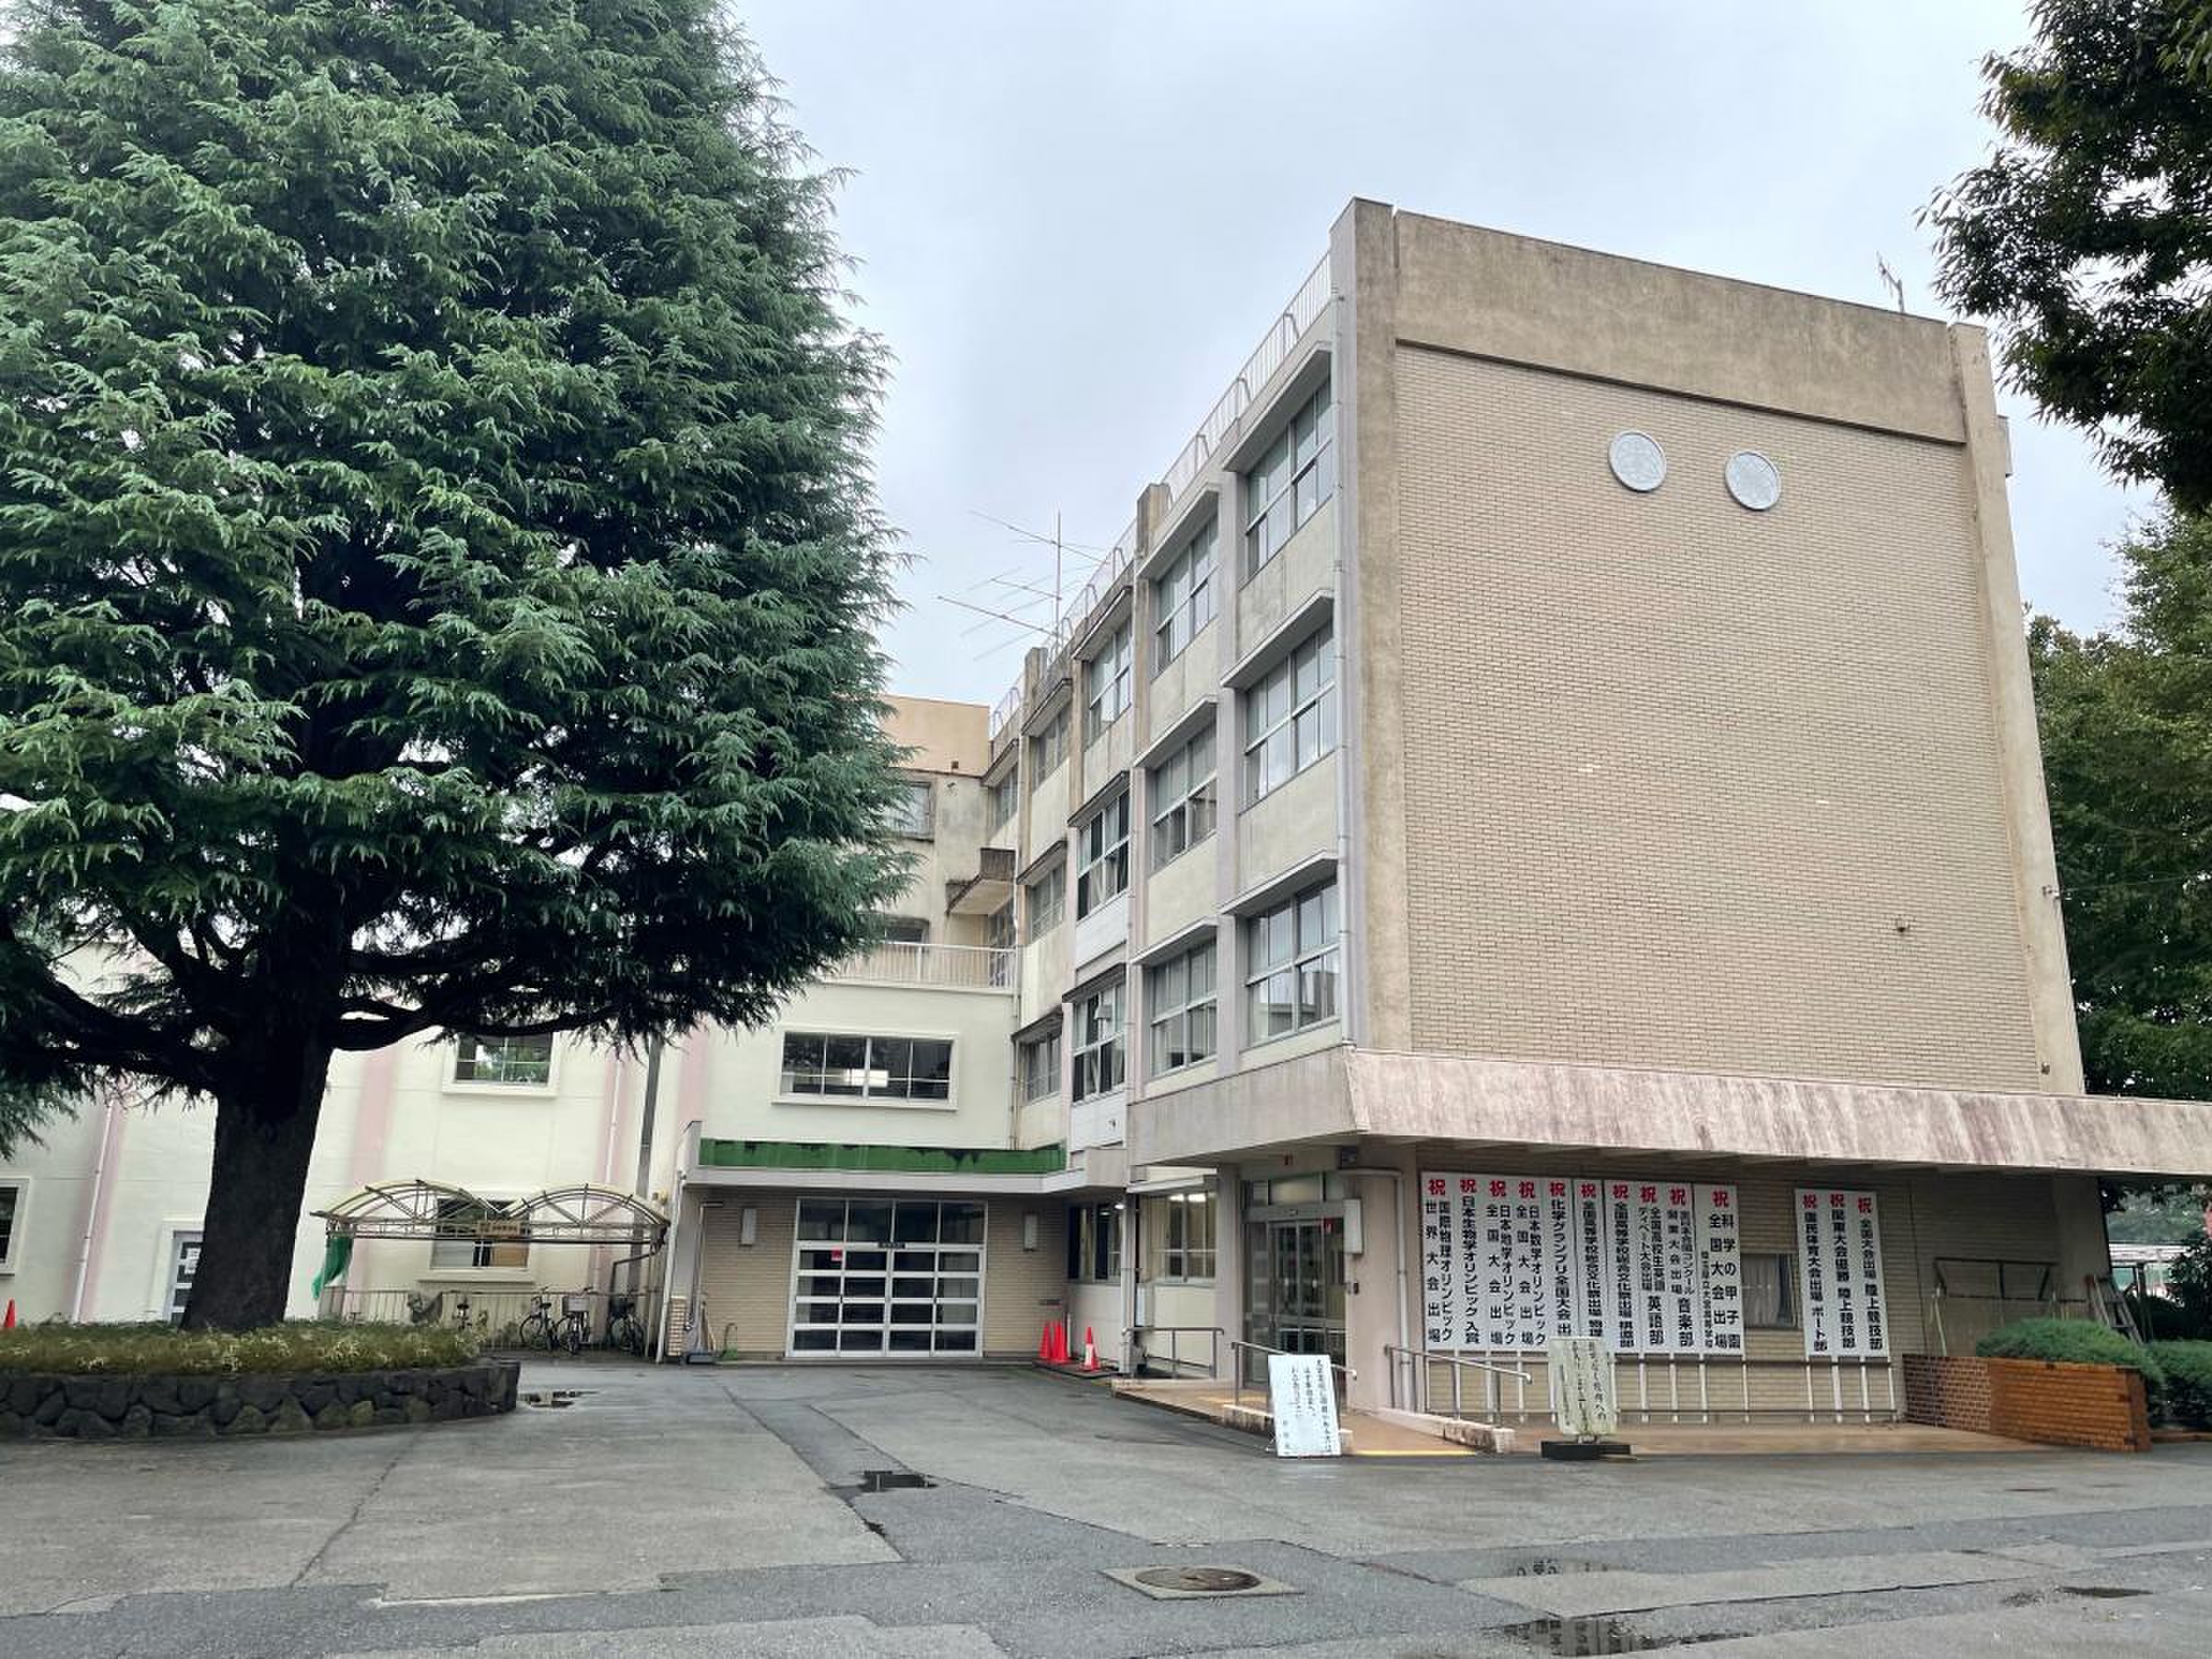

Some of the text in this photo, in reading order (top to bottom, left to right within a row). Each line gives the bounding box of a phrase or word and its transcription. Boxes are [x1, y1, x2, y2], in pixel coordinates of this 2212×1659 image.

[1430, 1179, 1445, 1195] 祝
[1460, 1179, 1477, 1194] 祝
[1488, 1181, 1506, 1196] 祝
[1518, 1181, 1535, 1198] 祝
[1549, 1182, 1566, 1197] 祝
[1581, 1183, 1596, 1198] 祝
[1613, 1184, 1629, 1198] 祝
[1641, 1186, 1656, 1203] 祝
[1669, 1188, 1686, 1206] 祝
[1712, 1191, 1728, 1207] 祝
[1803, 1194, 1818, 1208] 祝
[1830, 1194, 1844, 1207] 祝
[1857, 1197, 1872, 1213] 祝
[1551, 1199, 1571, 1335] 化学グランプリ全国大会出
[1710, 1213, 1727, 1348] 全国大会出場
[1723, 1214, 1740, 1348] 科学の甲子園
[1678, 1298, 1695, 1347] 音楽部
